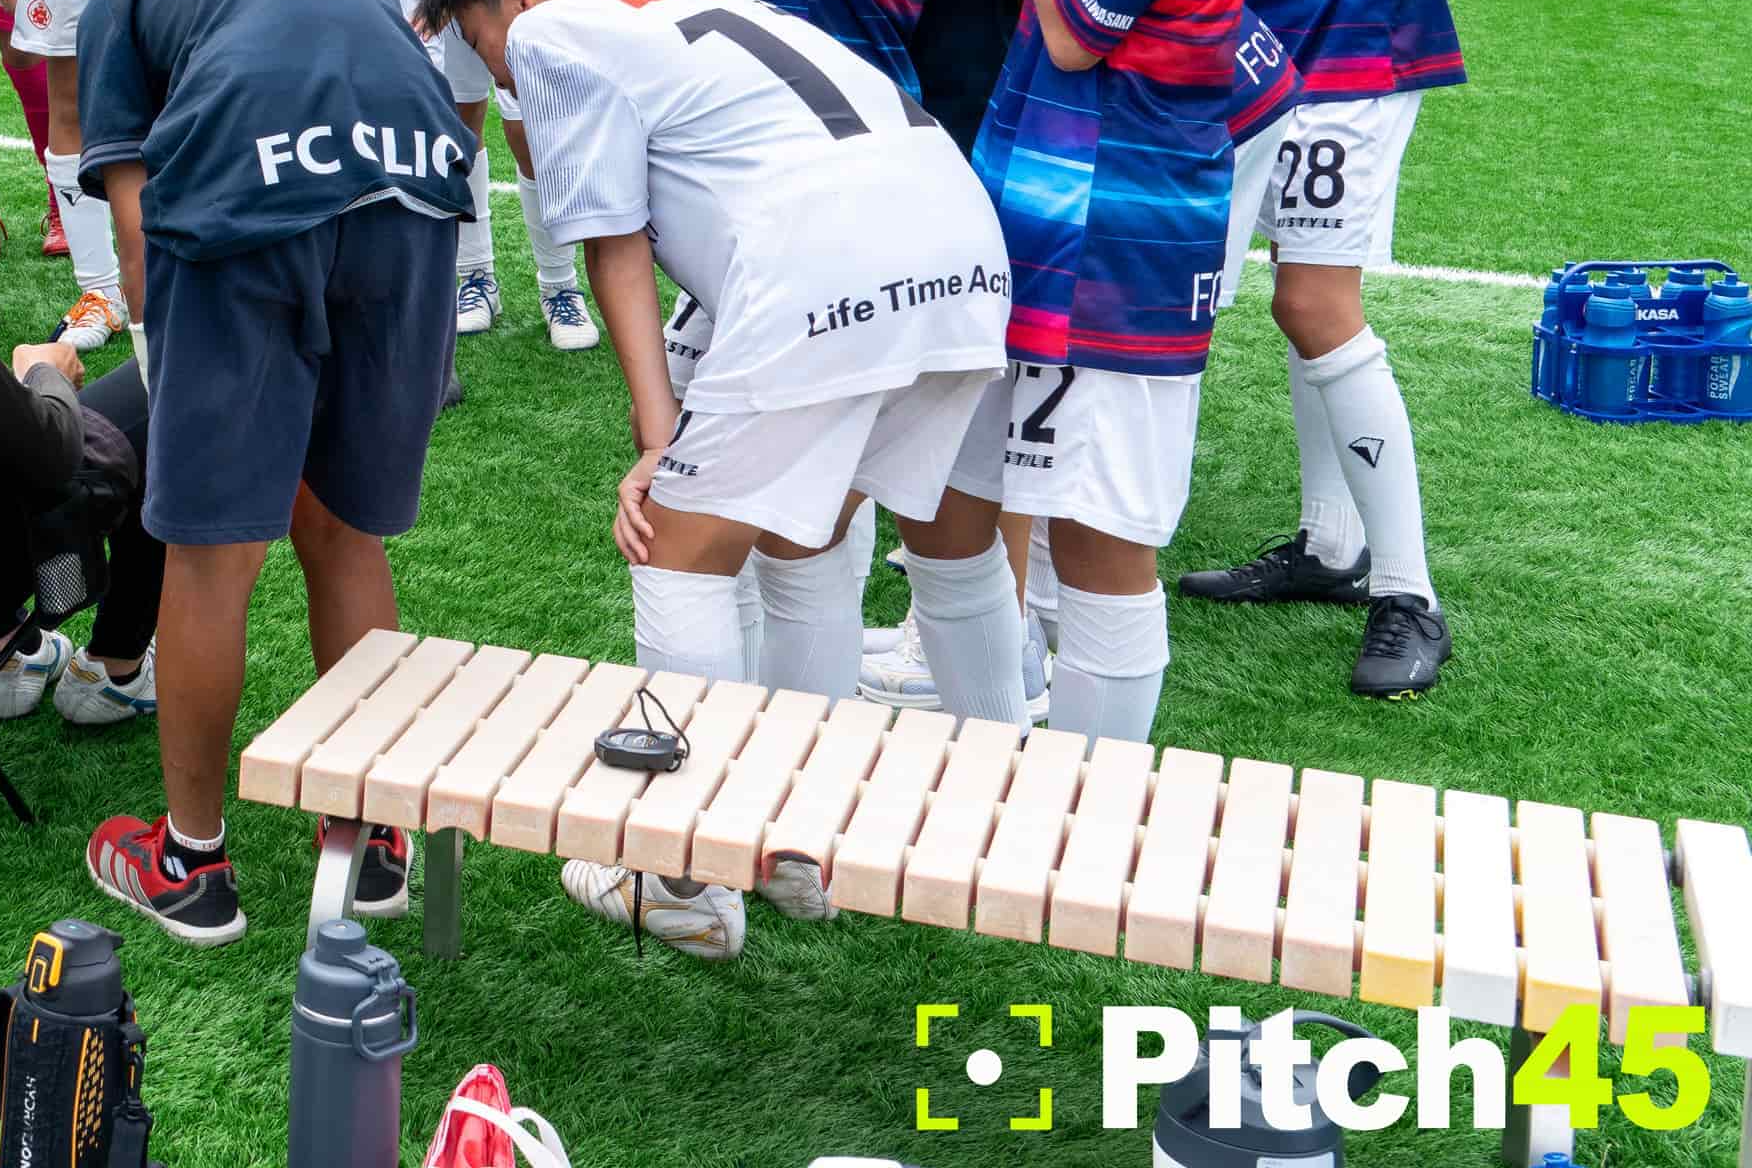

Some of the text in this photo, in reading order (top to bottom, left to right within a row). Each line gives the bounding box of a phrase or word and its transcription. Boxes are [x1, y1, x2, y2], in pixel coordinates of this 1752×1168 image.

[675, 0, 938, 141] 1
[256, 126, 343, 186] FC
[1277, 138, 1346, 209] 28
[1288, 217, 1345, 229] STYLE
[807, 296, 875, 338] Life
[879, 276, 962, 313] Time
[1008, 362, 1076, 444] 2
